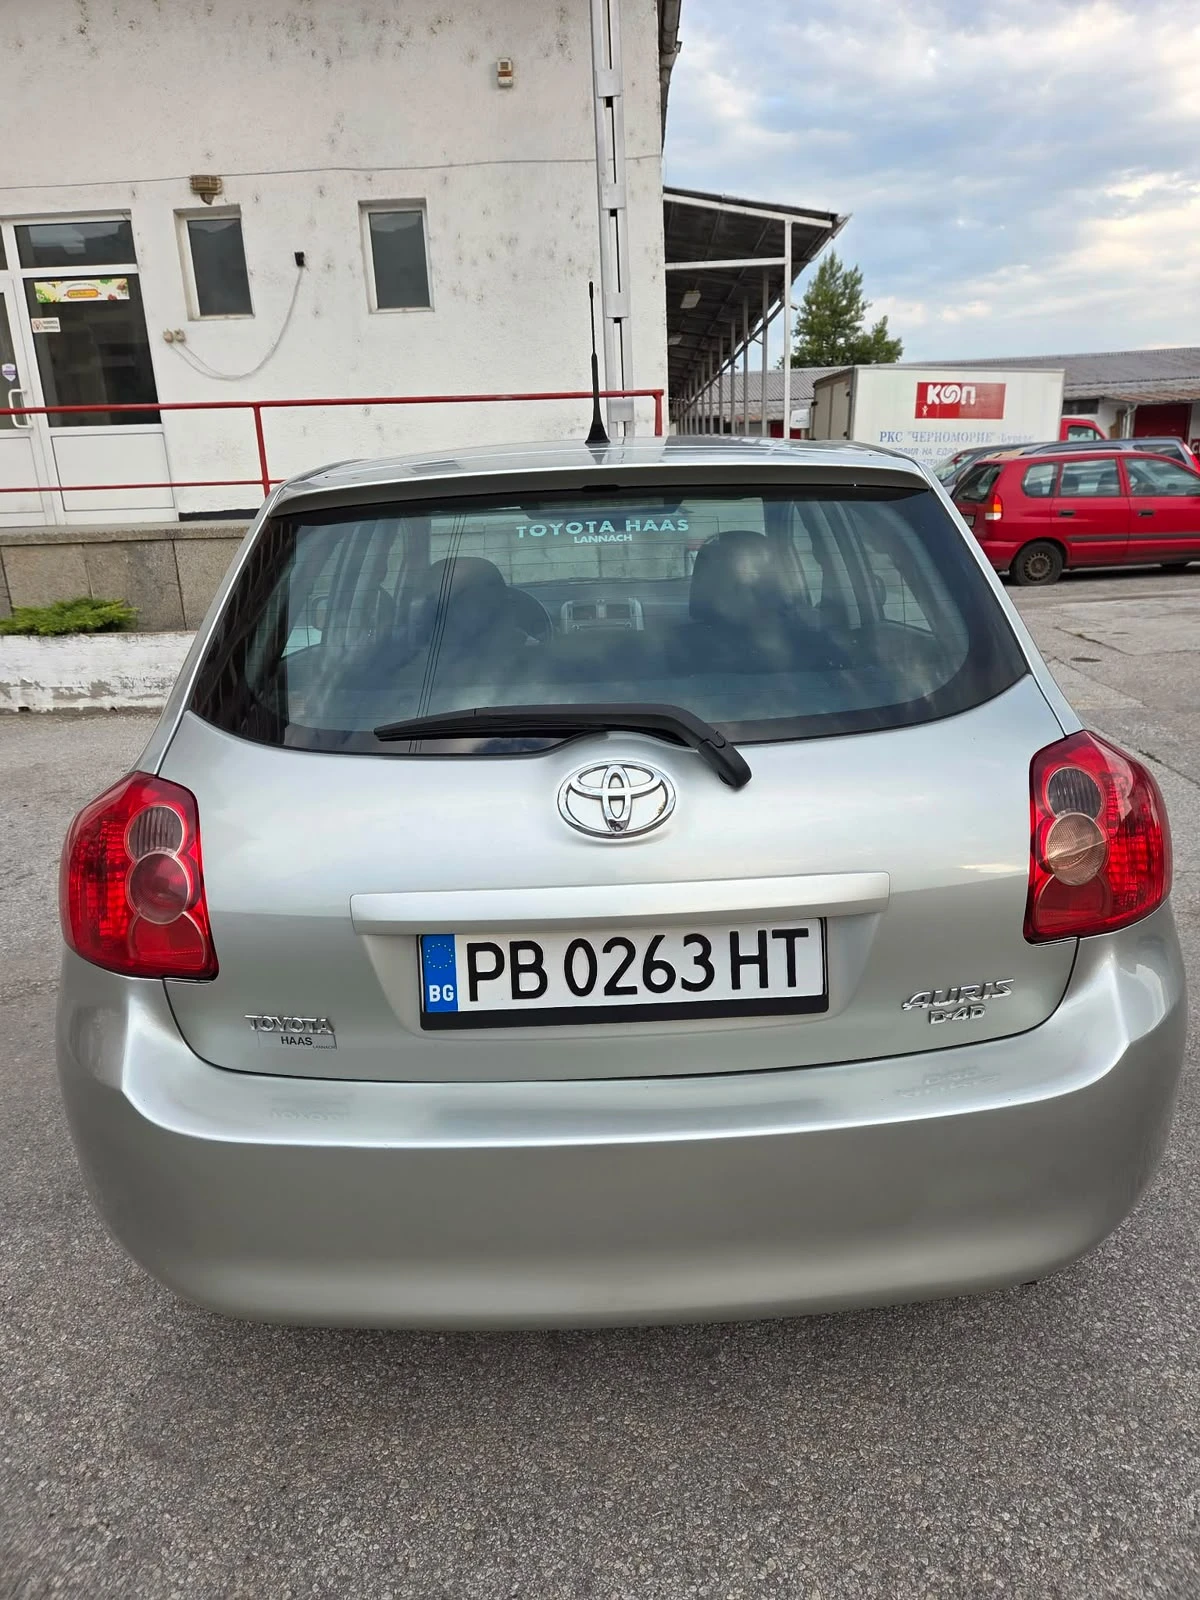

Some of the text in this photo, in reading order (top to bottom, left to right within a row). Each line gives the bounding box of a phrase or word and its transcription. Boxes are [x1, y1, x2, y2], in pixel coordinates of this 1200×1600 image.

[879, 431, 903, 443] РКС
[516, 519, 689, 538] TOYOTA HAAS
[574, 534, 633, 544] LANNACH
[466, 927, 809, 1002] PB 0263 HT
[428, 984, 455, 1003] BG
[901, 978, 1014, 1011] AURIS
[244, 1014, 335, 1034] TOYOTA
[929, 1004, 986, 1025] D-4D
[280, 1036, 313, 1046] HAAS
